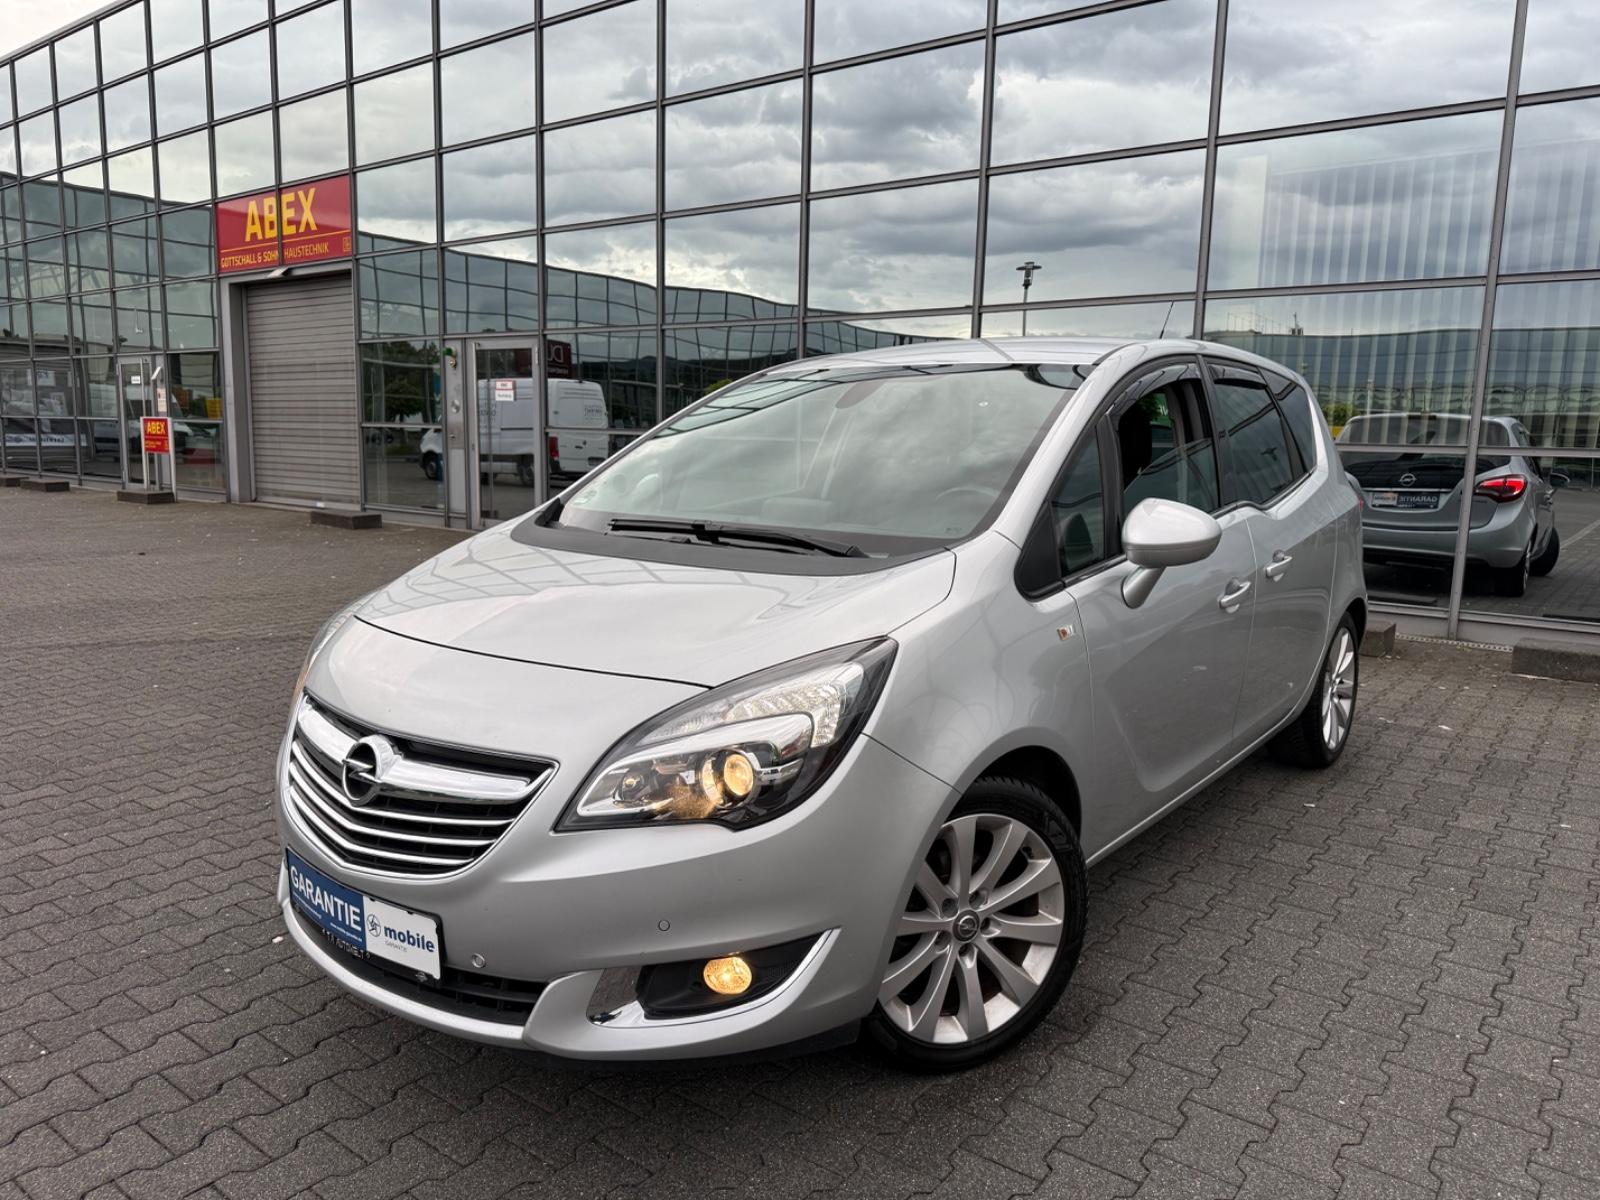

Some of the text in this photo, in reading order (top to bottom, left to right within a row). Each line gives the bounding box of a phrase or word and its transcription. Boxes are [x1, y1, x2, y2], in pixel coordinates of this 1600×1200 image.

[245, 187, 318, 242] ABEX
[221, 253, 257, 268] GOTTSCHALL
[257, 252, 263, 263] &
[284, 242, 329, 259] HAUSTECHNIK
[147, 420, 166, 435] ABEX
[290, 866, 362, 931] GARANTIE
[384, 926, 435, 952] mobile
